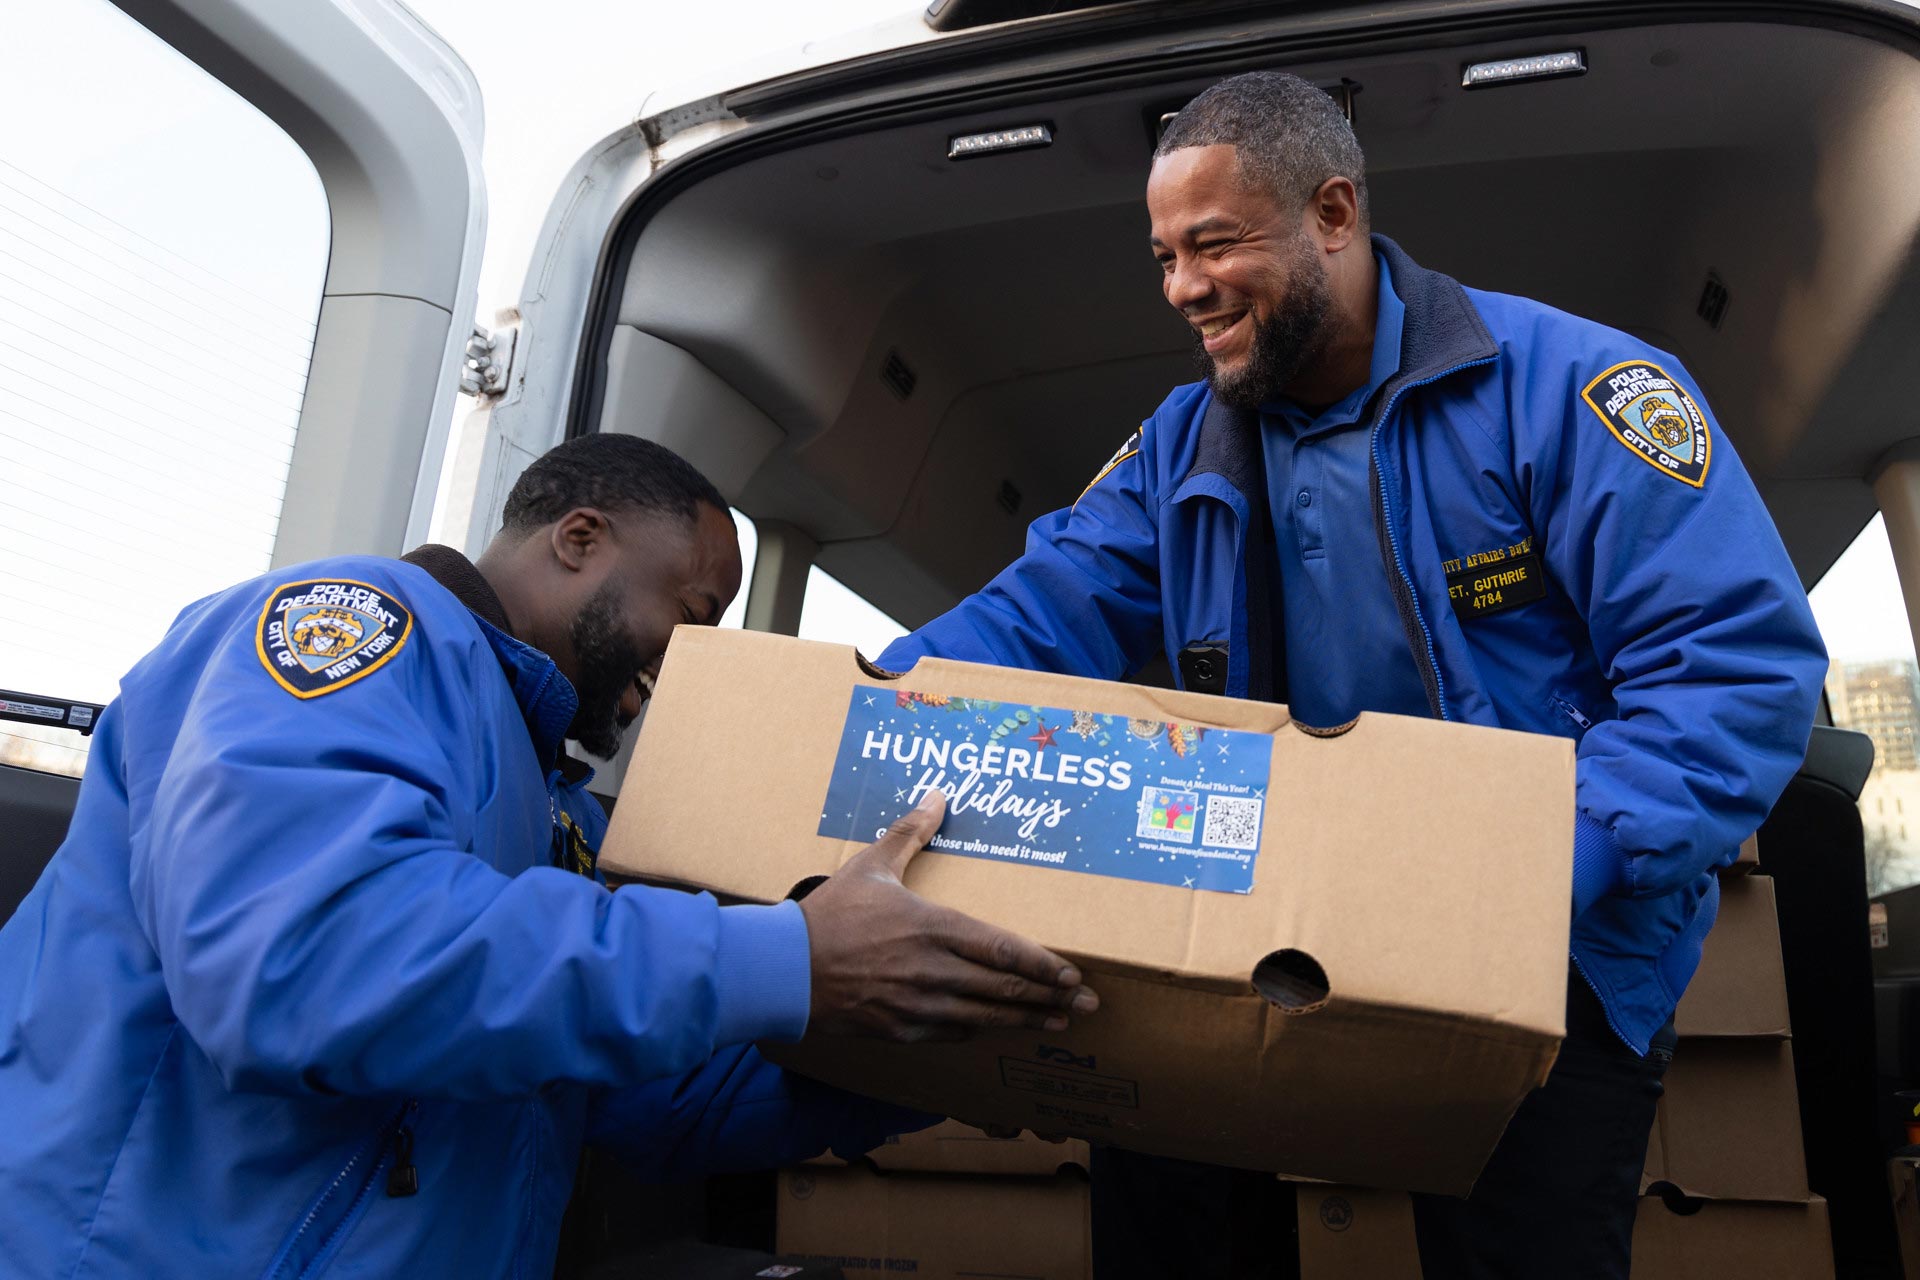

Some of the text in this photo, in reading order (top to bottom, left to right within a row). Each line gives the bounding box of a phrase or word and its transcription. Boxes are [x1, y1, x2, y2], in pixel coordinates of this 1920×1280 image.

[1605, 378, 1675, 416] DEPARTMENT
[1608, 368, 1653, 392] POLICE
[1680, 396, 1706, 465] NEW YORK
[1623, 429, 1680, 469] CITY OF
[1466, 548, 1505, 568] AFFAIRS
[310, 585, 381, 606] POLICE
[1448, 567, 1527, 598] ET. GUTHRIE
[1473, 590, 1503, 609] 4784
[275, 594, 398, 628] DEPARTMENT
[268, 621, 298, 667] CITY OF
[325, 632, 395, 680] NEW YORK
[861, 730, 1132, 790] HUNGERLESS
[1160, 776, 1249, 793] Donate A Meal This Year!
[907, 767, 1071, 839] Holidays
[930, 834, 1066, 864] those who need it most!
